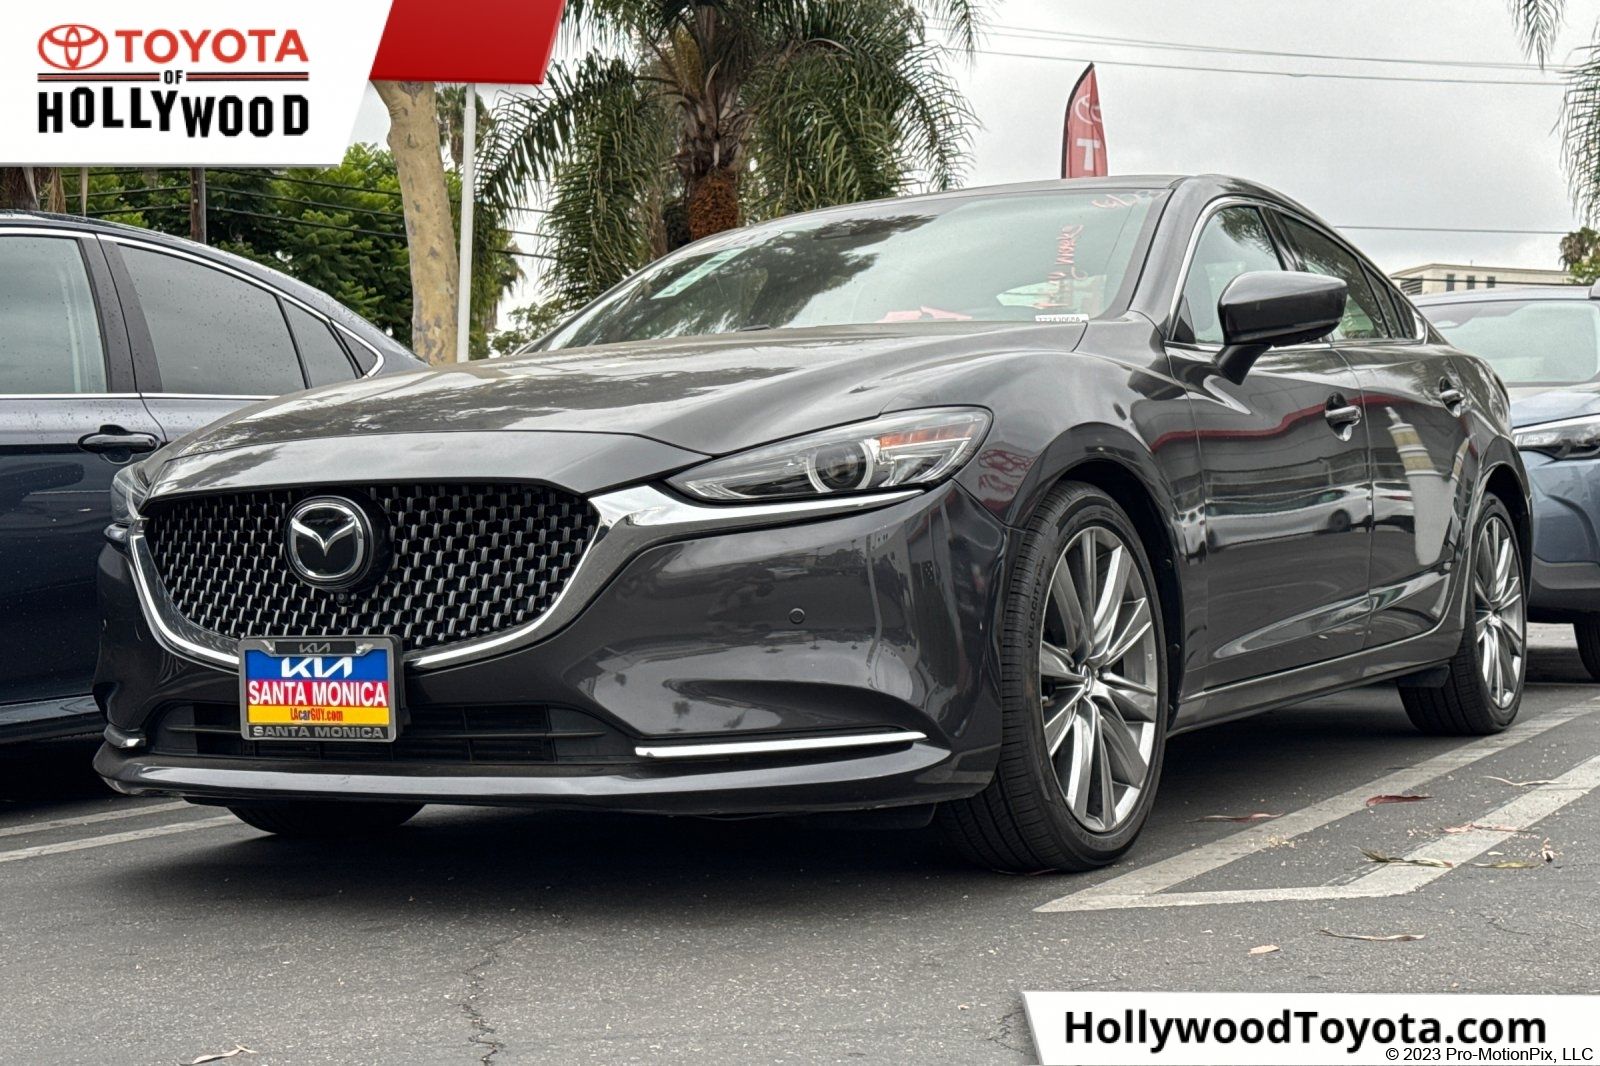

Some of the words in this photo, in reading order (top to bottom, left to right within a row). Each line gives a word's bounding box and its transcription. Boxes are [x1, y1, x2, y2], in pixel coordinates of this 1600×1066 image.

[299, 642, 331, 654] KIA
[281, 656, 353, 679] KIA
[249, 680, 308, 706] SANTA
[312, 681, 387, 707] MONICA
[290, 707, 344, 722] LAcarGUY.com
[253, 725, 311, 738] SANTA
[314, 726, 385, 739] MONICA
